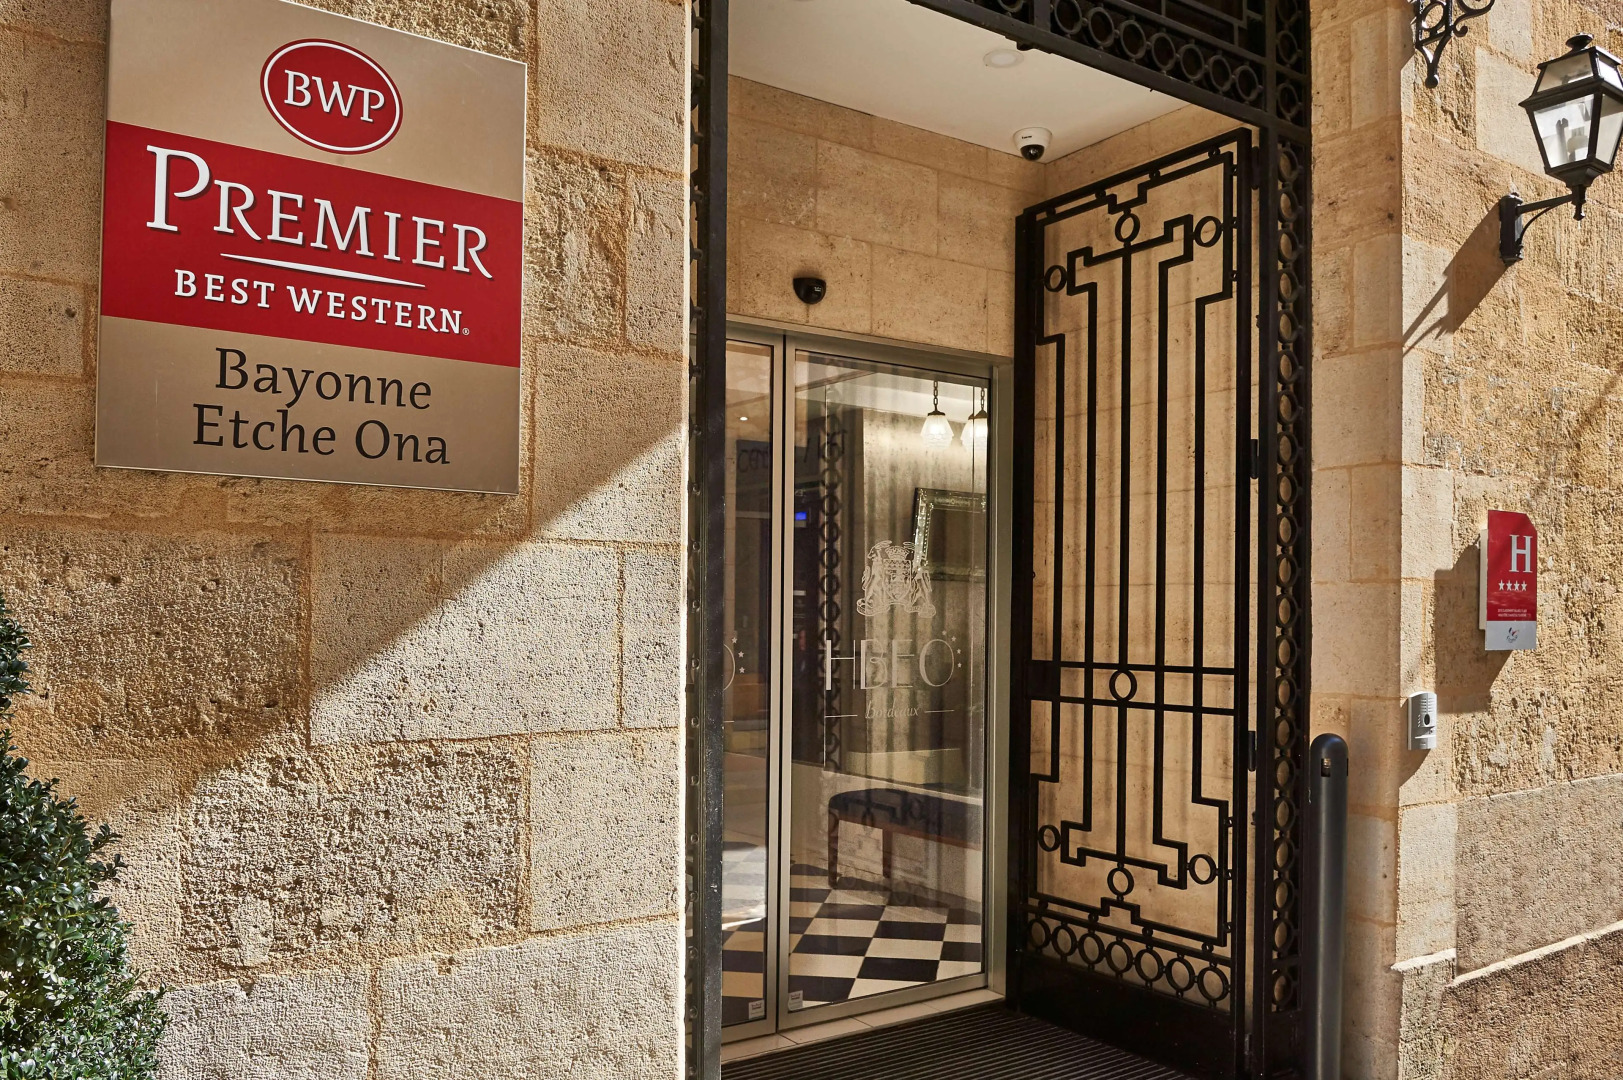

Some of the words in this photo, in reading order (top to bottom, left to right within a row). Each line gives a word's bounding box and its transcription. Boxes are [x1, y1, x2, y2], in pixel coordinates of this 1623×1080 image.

[284, 69, 385, 123] BWP
[146, 145, 493, 279] PREMIER
[174, 269, 275, 308] BEST
[215, 347, 432, 410] Bayonne
[193, 403, 336, 456] Etche
[355, 419, 450, 465] Ona
[1509, 534, 1533, 573] H
